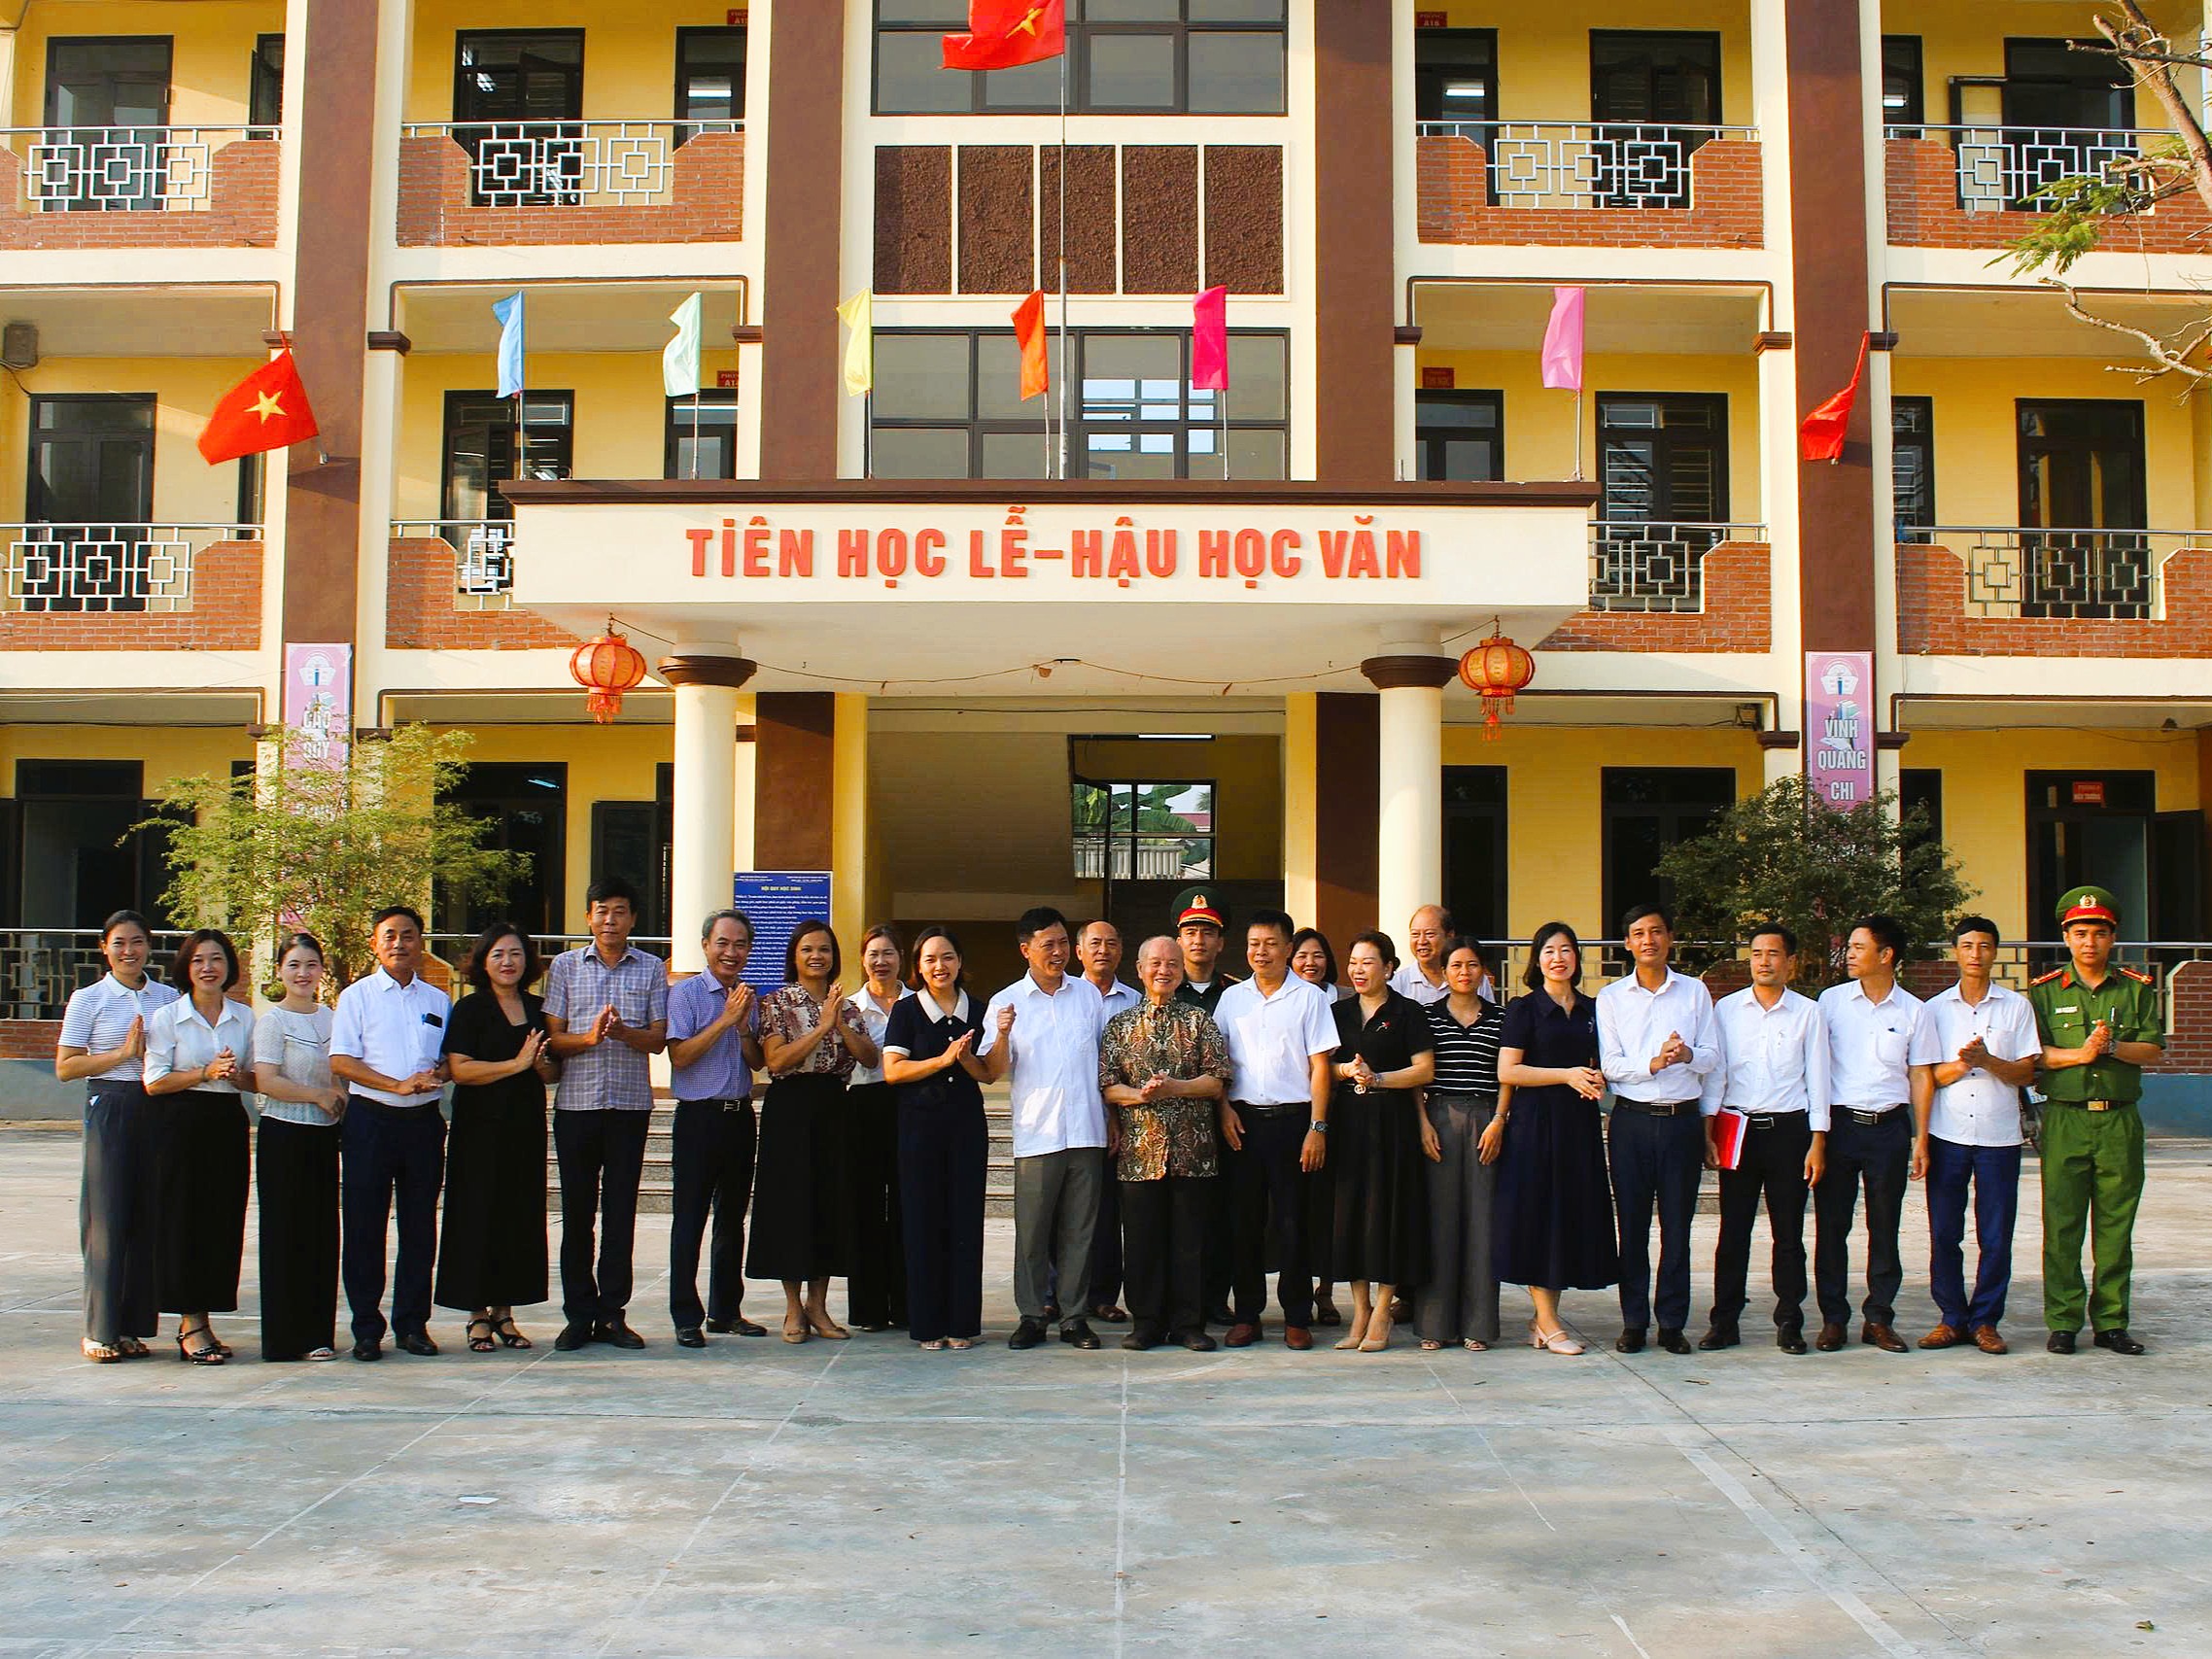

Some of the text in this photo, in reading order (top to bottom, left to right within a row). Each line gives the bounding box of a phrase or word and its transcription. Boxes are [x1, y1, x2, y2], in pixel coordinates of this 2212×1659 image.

[837, 528, 947, 589] HỌC
[1198, 528, 1301, 589] HỌC
[1318, 515, 1422, 578] VĂN
[1824, 719, 1858, 739] VINH
[1817, 750, 1867, 771] QUANG
[1830, 781, 1854, 801] CHI
